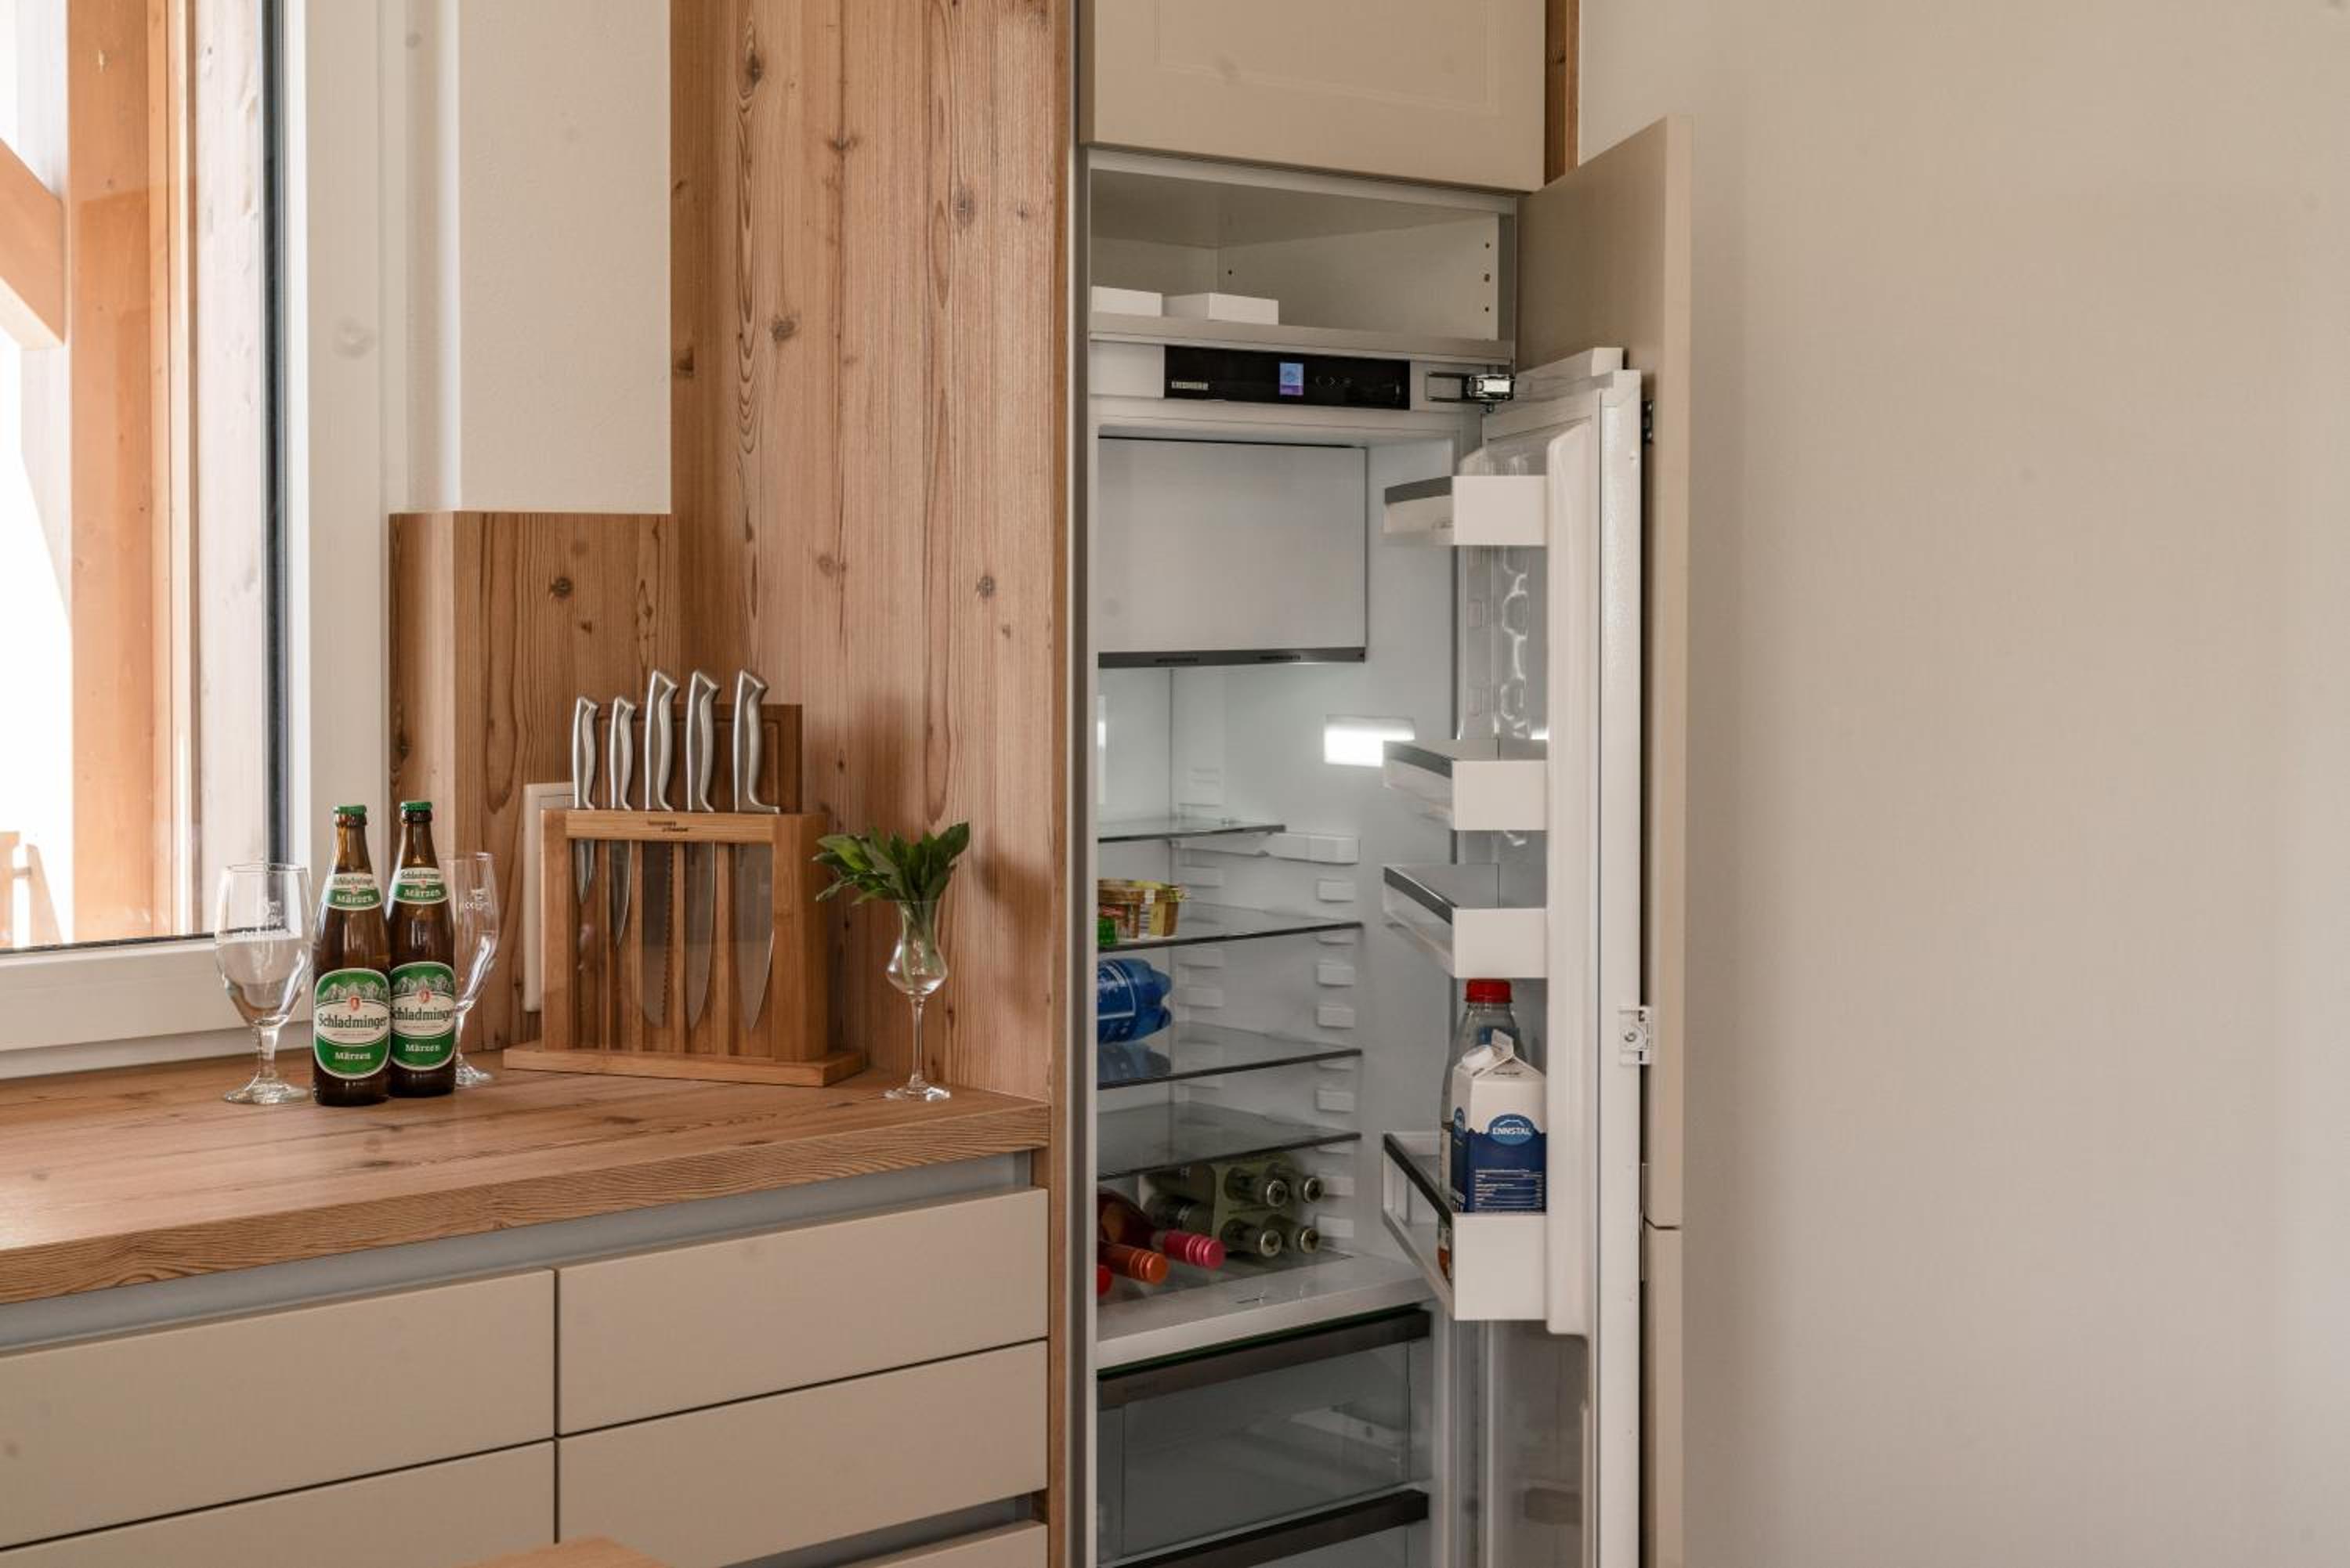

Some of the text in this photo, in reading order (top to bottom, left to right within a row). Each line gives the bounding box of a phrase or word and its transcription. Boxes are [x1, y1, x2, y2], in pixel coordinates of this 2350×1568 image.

[318, 1012, 387, 1030] Schladminger
[405, 1043, 441, 1052] Märzen
[334, 1051, 371, 1060] Märzen
[1492, 1127, 1531, 1136] ENNSTAL
